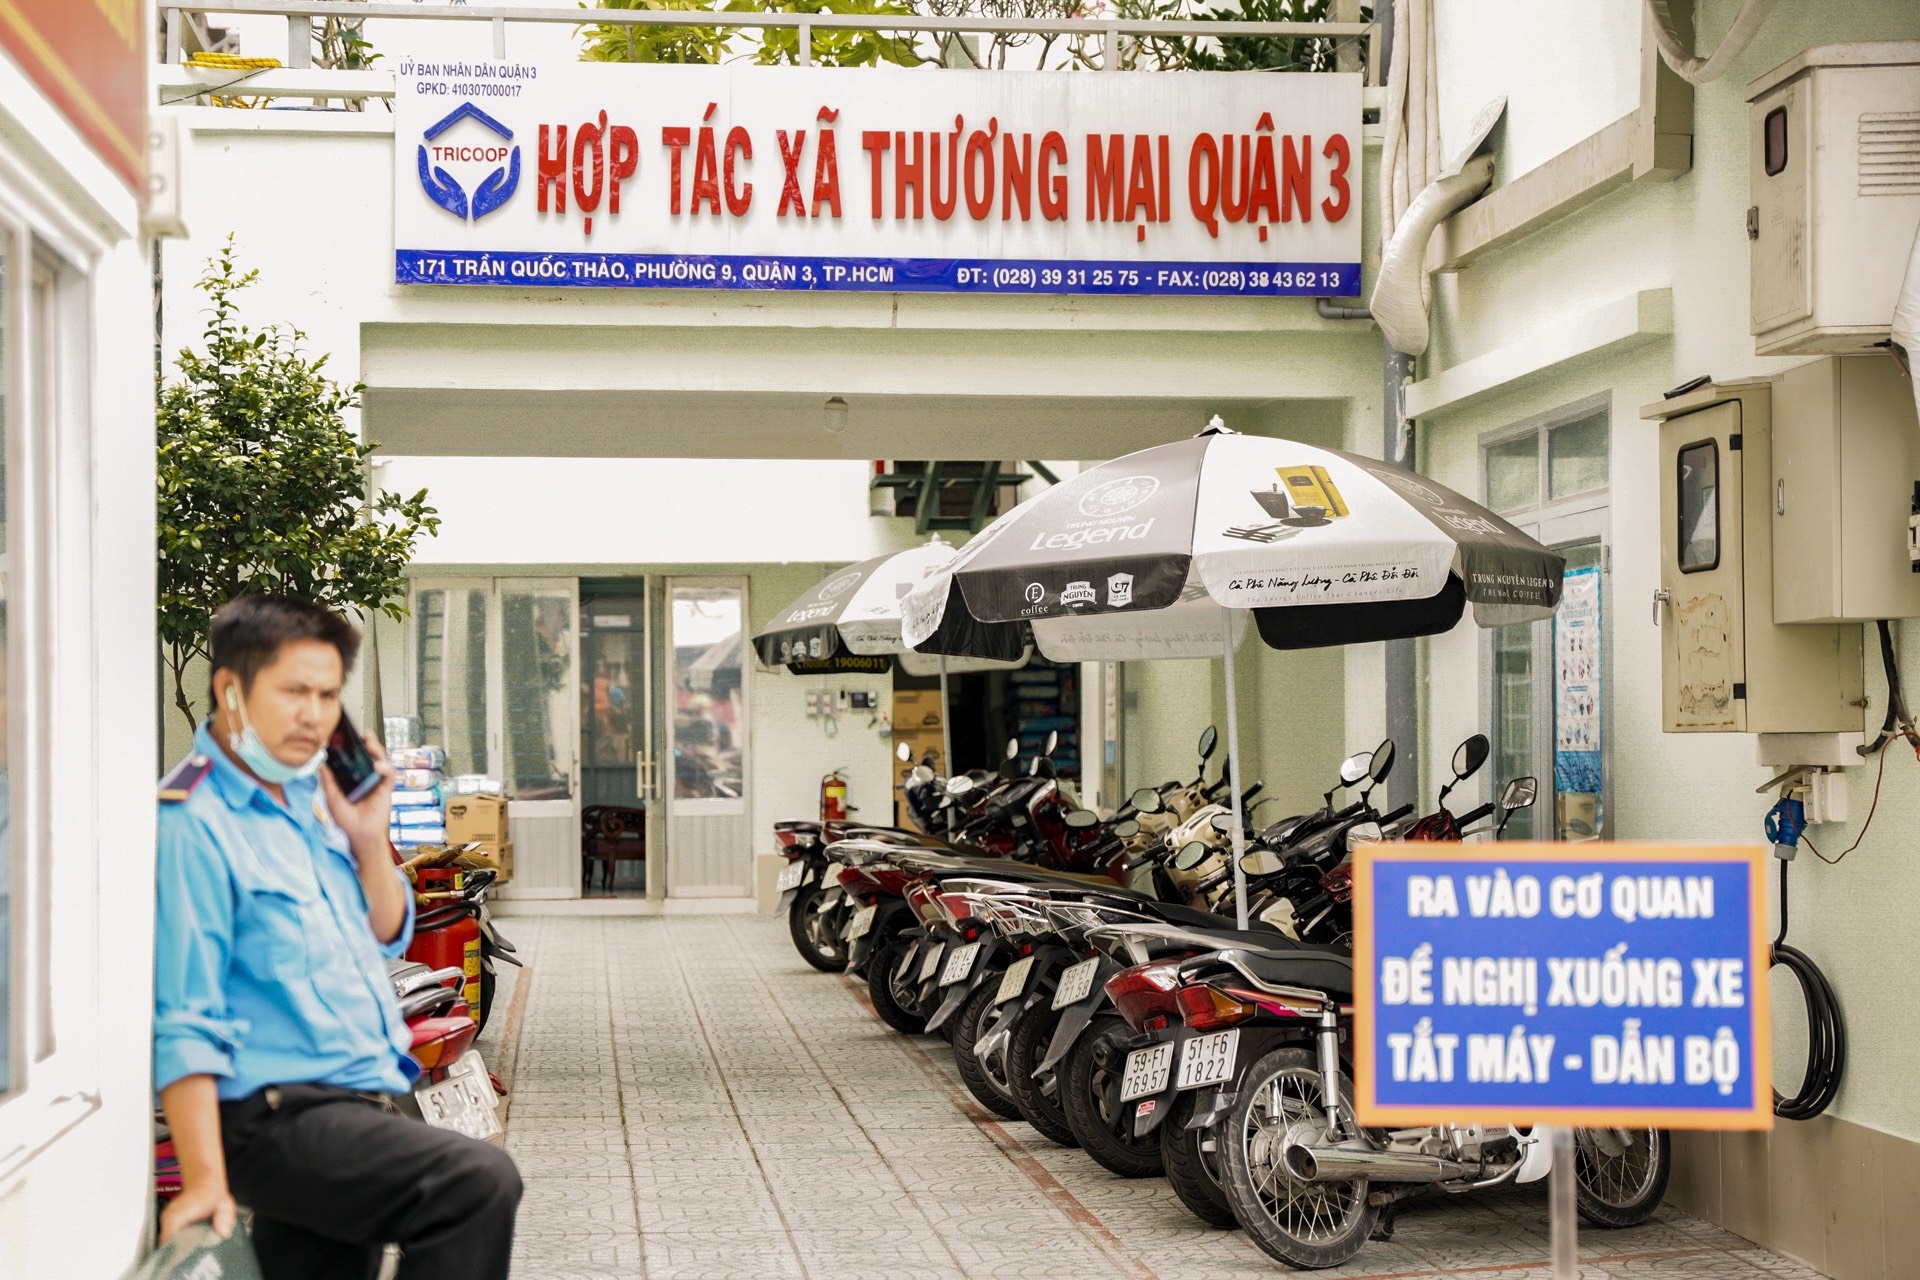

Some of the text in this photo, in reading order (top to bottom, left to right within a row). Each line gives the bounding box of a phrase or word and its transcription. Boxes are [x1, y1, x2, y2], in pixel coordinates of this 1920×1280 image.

[417, 63, 439, 76] BAN
[443, 62, 472, 77] NHÂN
[474, 63, 496, 78] DÂN
[498, 64, 529, 81] QUẬN
[530, 67, 537, 79] 3
[416, 82, 522, 97] GPKD: 410307000017
[432, 146, 509, 164] TRICOOP
[537, 102, 1351, 242] HỢP TÁC XÃ THƯƠNG MẠI QUẬN 3
[417, 254, 894, 284] 171 TRẦN QUỐC THẢO, PHƯỜNG 9, QUẬN 3, TP.HCM
[957, 268, 987, 284] ĐT:
[992, 268, 1036, 288] (028)
[1041, 269, 1062, 285] 39
[1067, 269, 1086, 285] 31
[1092, 270, 1113, 286] 25
[1118, 270, 1139, 286] 75
[1157, 270, 1200, 287] FAX:
[1202, 270, 1246, 290] (028)
[1272, 271, 1292, 287] 43
[1295, 271, 1316, 287] 62
[1319, 272, 1340, 288] 13
[1030, 517, 1156, 551] Legend
[1110, 582, 1130, 594] G7
[1472, 572, 1495, 584] TRUNG
[1020, 604, 1049, 615] coffee
[834, 657, 885, 668] 19006011
[1407, 867, 1715, 923] RA VÀO CƠ QUAN
[1442, 956, 1538, 1016] NGHỊ
[1546, 942, 1683, 1008] XUỐNG
[1692, 957, 1744, 1008] XE
[1188, 1033, 1229, 1060] 51-F6
[1387, 1016, 1740, 1095] TẮT MÁY - DẪN BỘ
[1133, 1047, 1166, 1074] 59-F1
[1186, 1057, 1225, 1085] 1822
[1124, 1067, 1167, 1098] 769.57
